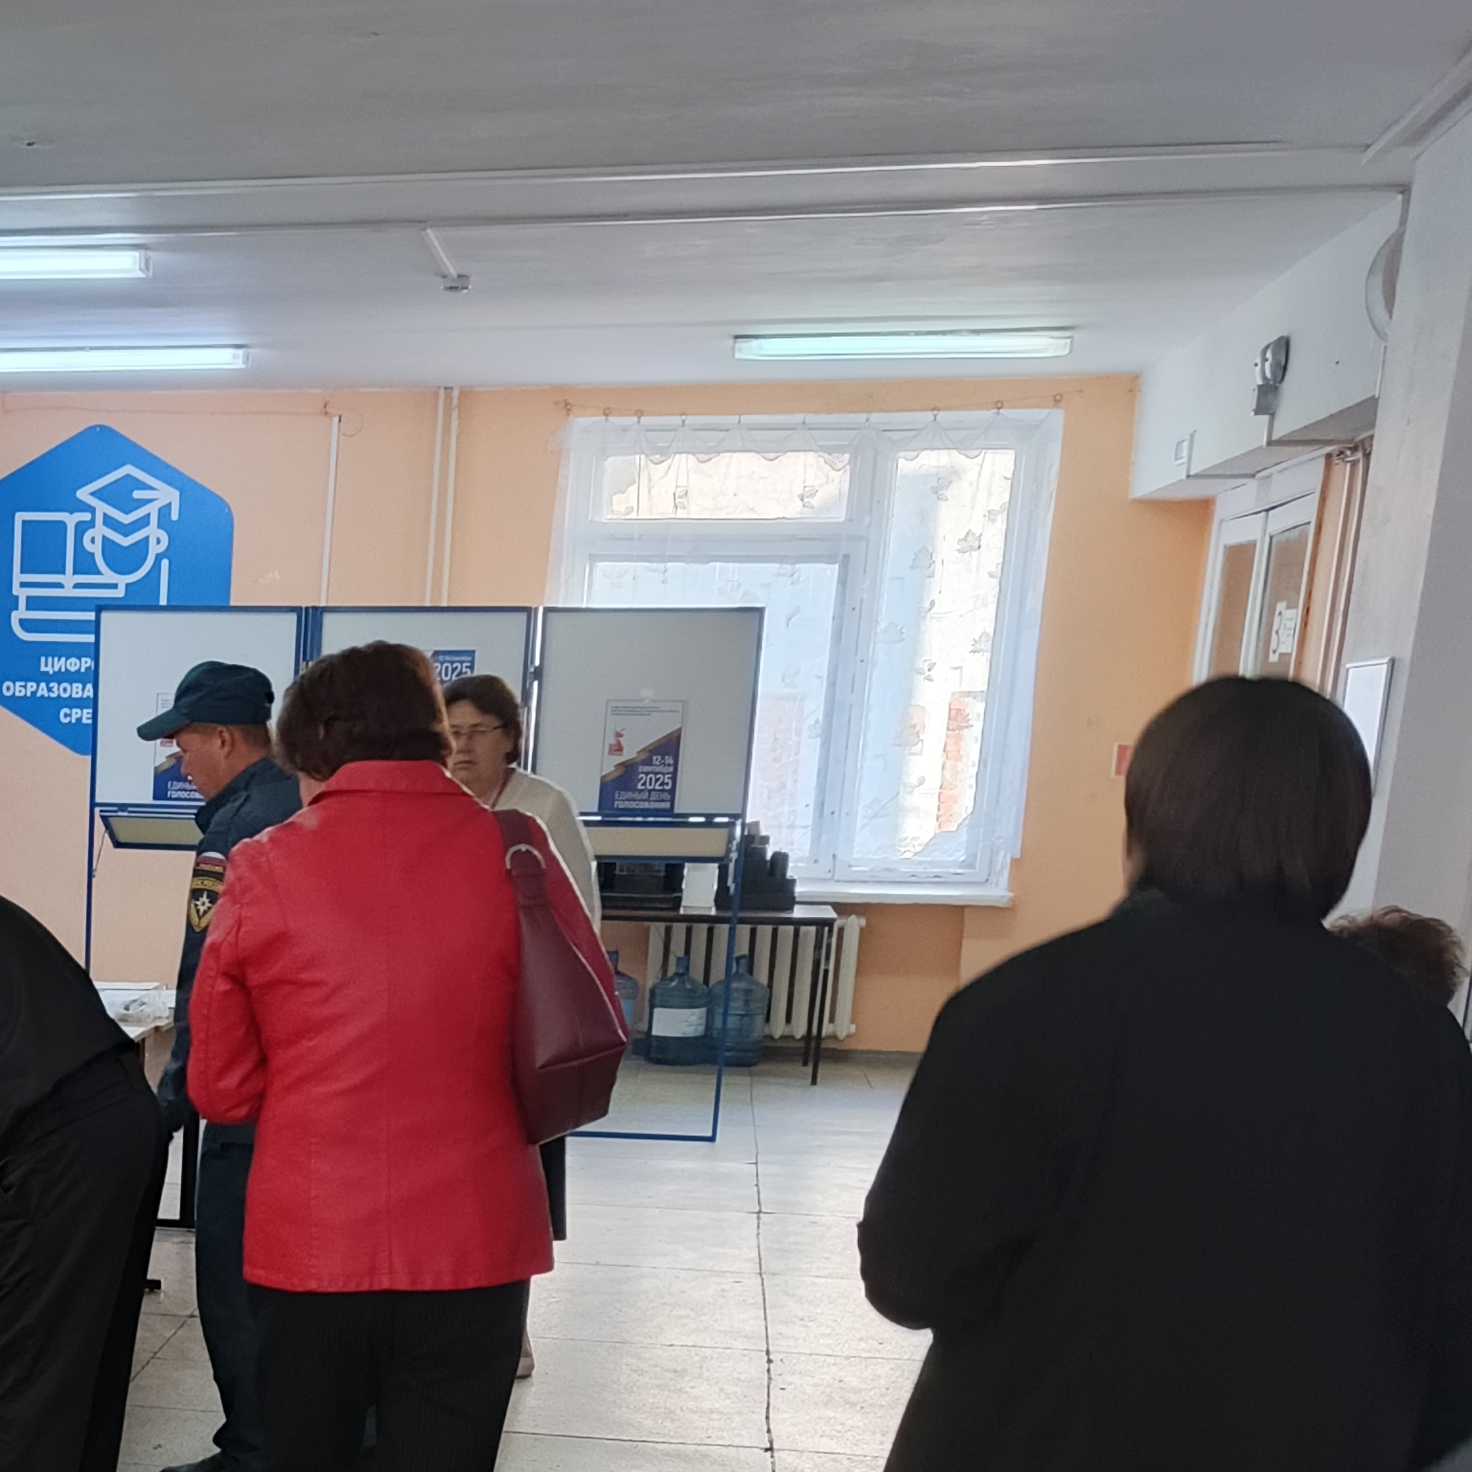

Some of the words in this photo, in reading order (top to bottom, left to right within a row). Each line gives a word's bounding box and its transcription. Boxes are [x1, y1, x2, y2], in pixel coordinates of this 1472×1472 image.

[2, 681, 93, 698] ОБРАЗОВА
[652, 755, 674, 765] 12-14
[637, 774, 673, 790] 2025
